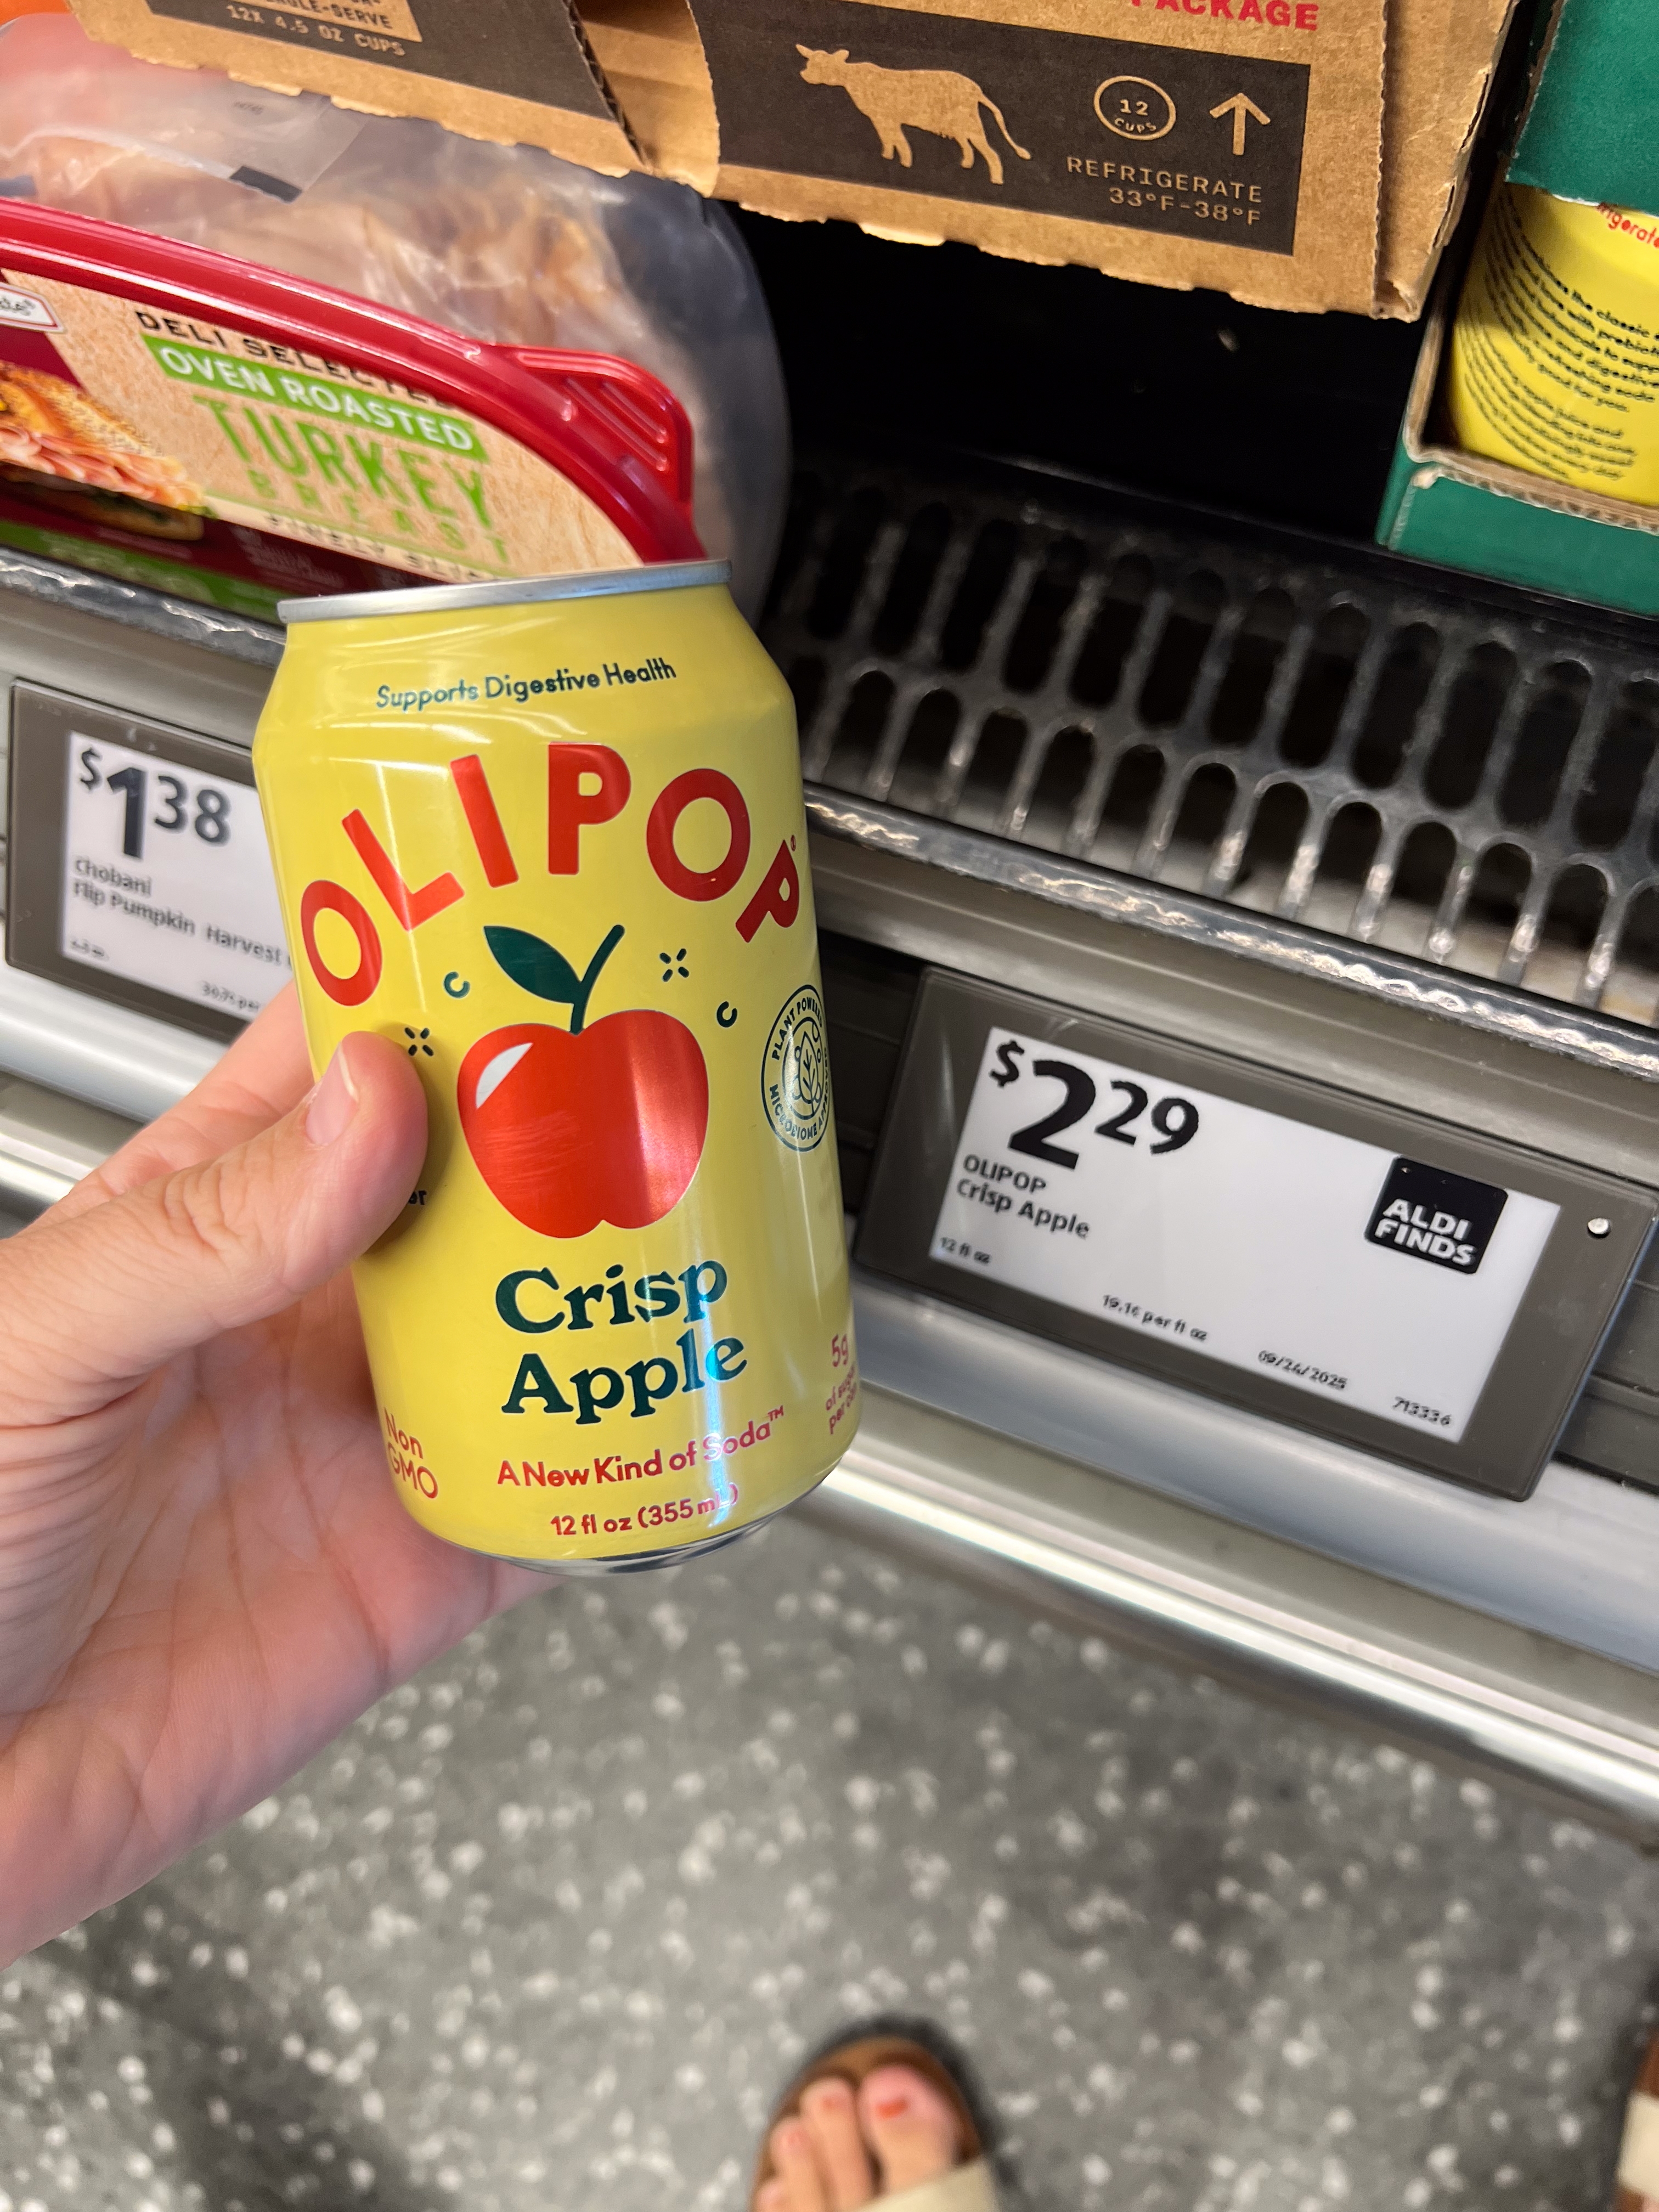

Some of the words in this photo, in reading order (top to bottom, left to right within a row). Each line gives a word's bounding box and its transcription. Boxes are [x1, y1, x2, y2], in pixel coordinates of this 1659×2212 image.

[317, 25, 345, 43] OZ
[354, 33, 405, 57] CUPS
[1114, 117, 1157, 134] CUPS
[1119, 99, 1149, 116] 12
[1066, 156, 1262, 204] REFRIGERATE
[136, 311, 227, 348] DELI
[160, 347, 276, 397] OVEN
[278, 375, 473, 451] ROASTED
[192, 393, 492, 528] TURKEY
[376, 679, 479, 712] Supports
[486, 668, 600, 702] Digestive
[603, 657, 676, 686] Health
[110, 889, 196, 935] Pumpkin
[206, 922, 281, 966] Harvest
[771, 1007, 795, 1060] PLANT
[770, 1084, 818, 1141] MICROBIOME
[962, 1153, 1047, 1194] OLIPOP
[956, 1178, 1012, 1214] Crisp
[1018, 1200, 1090, 1239] Apple
[1381, 1198, 1470, 1242] ALDI
[940, 1237, 957, 1252] 12
[958, 1242, 970, 1258] fl
[974, 1251, 991, 1265] oz
[1373, 1217, 1477, 1266] FINDS
[495, 1260, 729, 1334] Crisp
[1142, 1310, 1171, 1329] per
[1174, 1318, 1186, 1334] fl
[1189, 1328, 1207, 1343] oz
[831, 1334, 849, 1367] 5g
[501, 1329, 747, 1425] Apple
[825, 1385, 837, 1410] of
[384, 1407, 424, 1459] Non
[829, 1401, 845, 1435] per
[387, 1442, 438, 1499] GMO
[497, 1460, 521, 1485] A
[522, 1461, 590, 1487] New
[594, 1448, 663, 1483] Kind
[668, 1440, 697, 1471] of
[550, 1515, 577, 1536] 12
[581, 1514, 597, 1534] fl
[603, 1517, 633, 1533] oz
[637, 1498, 693, 1529] (355
